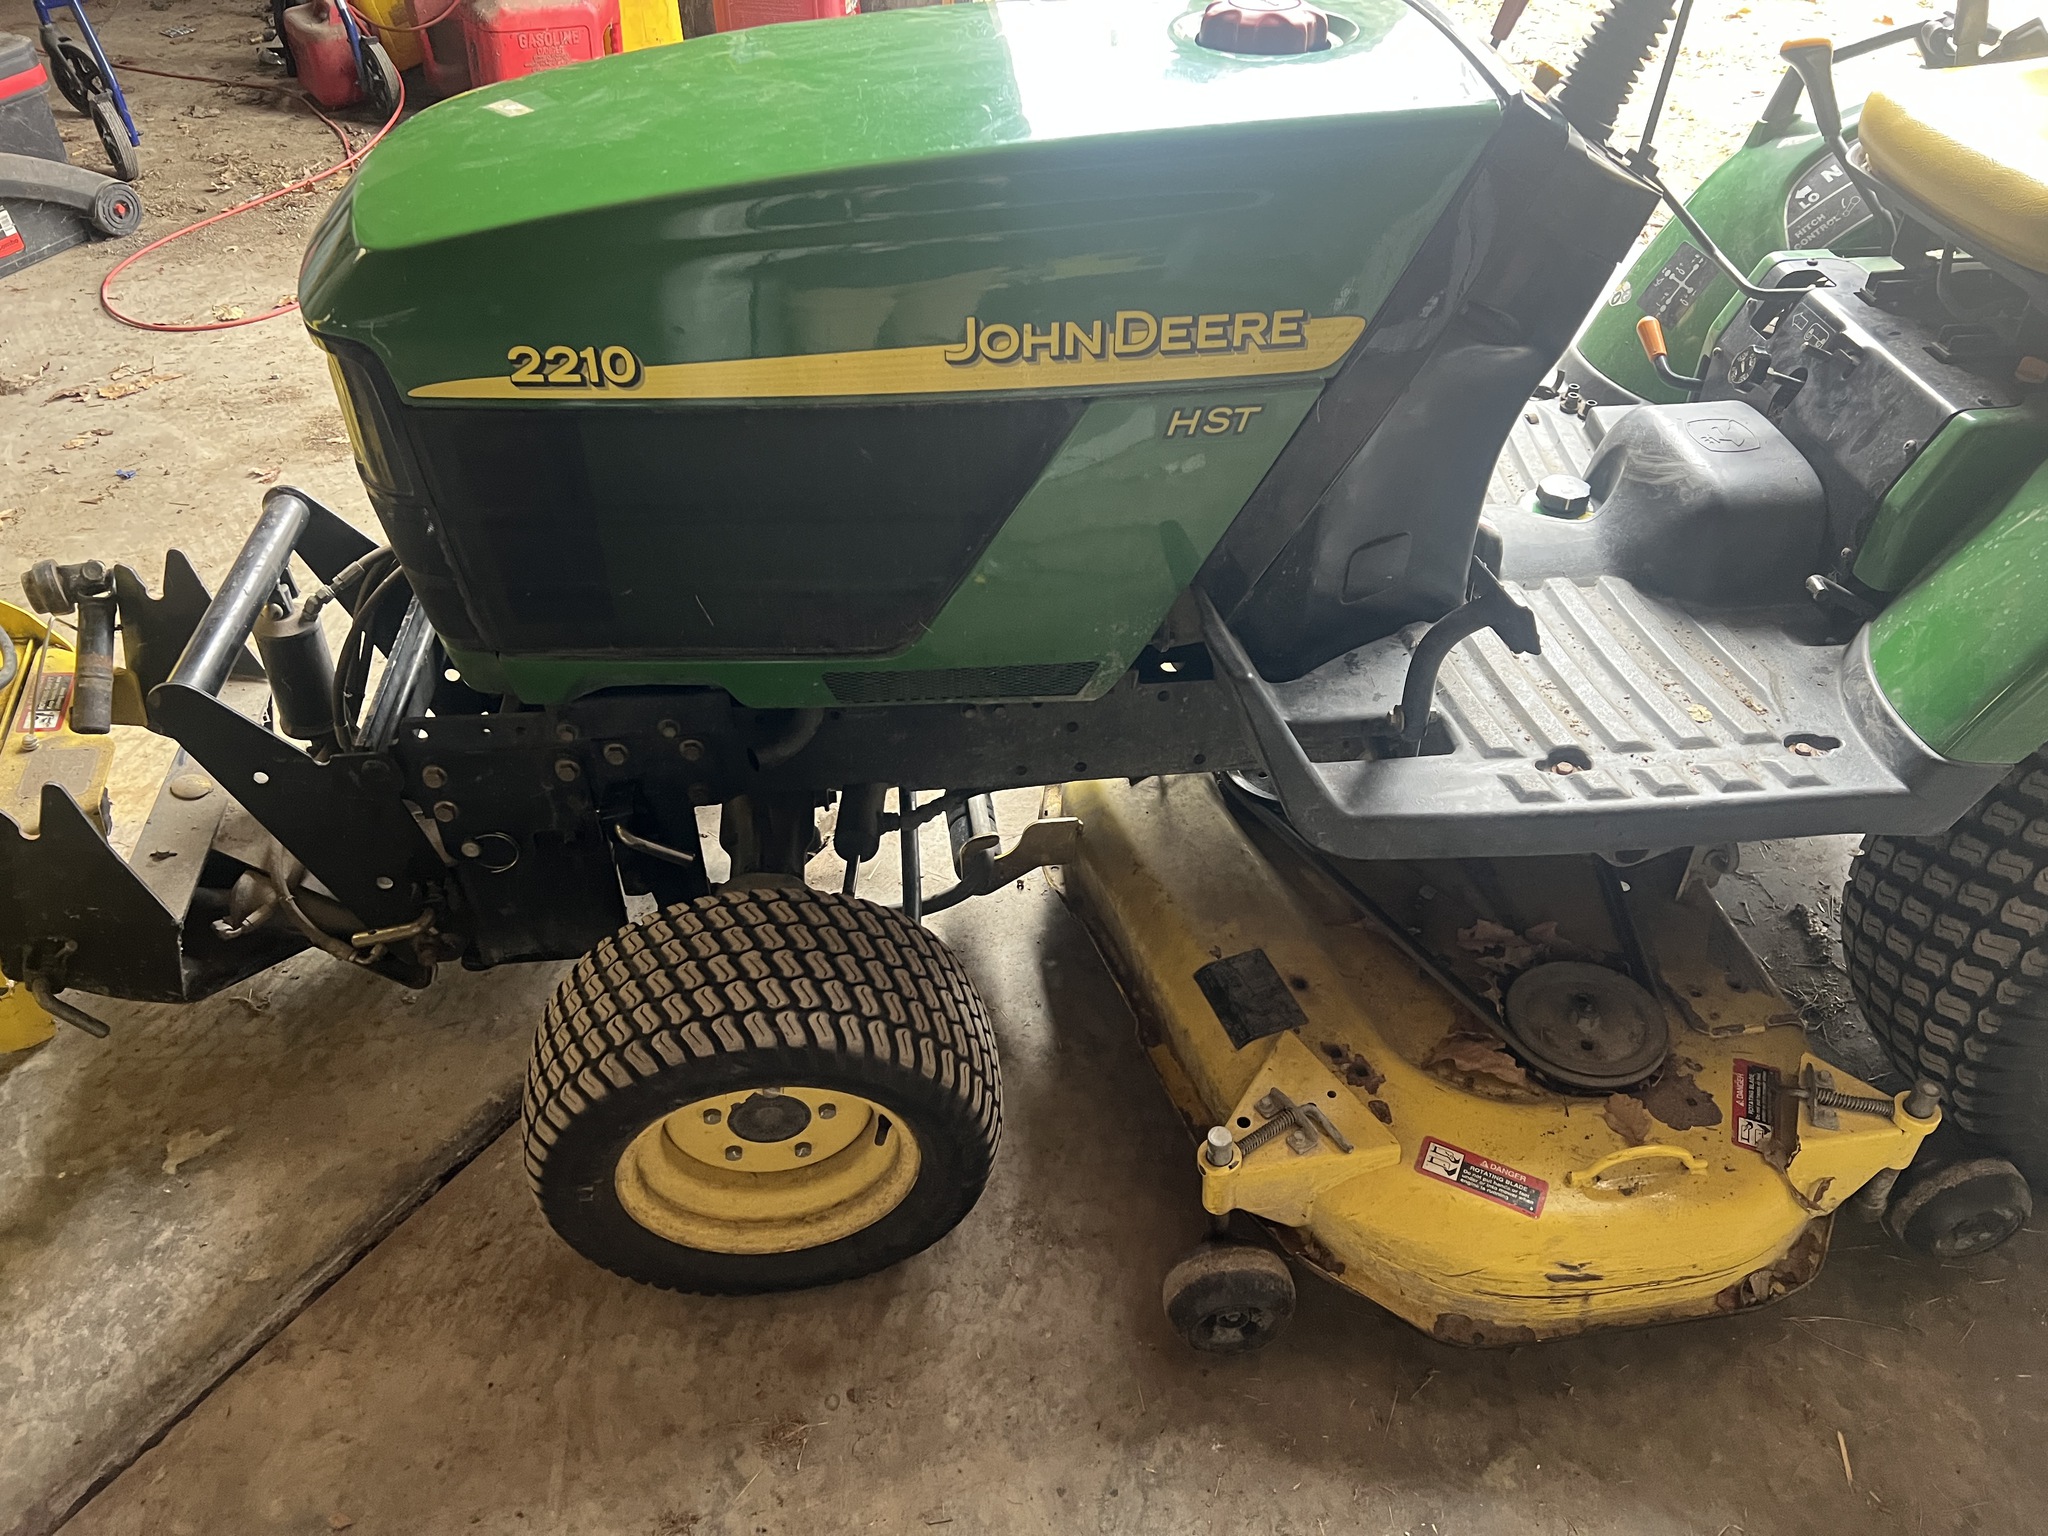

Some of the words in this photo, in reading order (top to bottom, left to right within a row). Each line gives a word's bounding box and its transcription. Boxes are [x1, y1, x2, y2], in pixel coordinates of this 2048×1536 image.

[517, 30, 579, 49] GASOLINE
[1820, 164, 1843, 183] N
[1798, 192, 1820, 209] LO
[1793, 215, 1842, 250] CONTROL
[1794, 213, 1826, 239] HITCH
[507, 345, 643, 389] 2210
[1166, 406, 1262, 437] HST
[1736, 1073, 1745, 1099] DANGER
[1469, 1165, 1504, 1183] ROTATING
[1505, 1179, 1528, 1191] BLADE
[1490, 1162, 1527, 1183] DANGER
